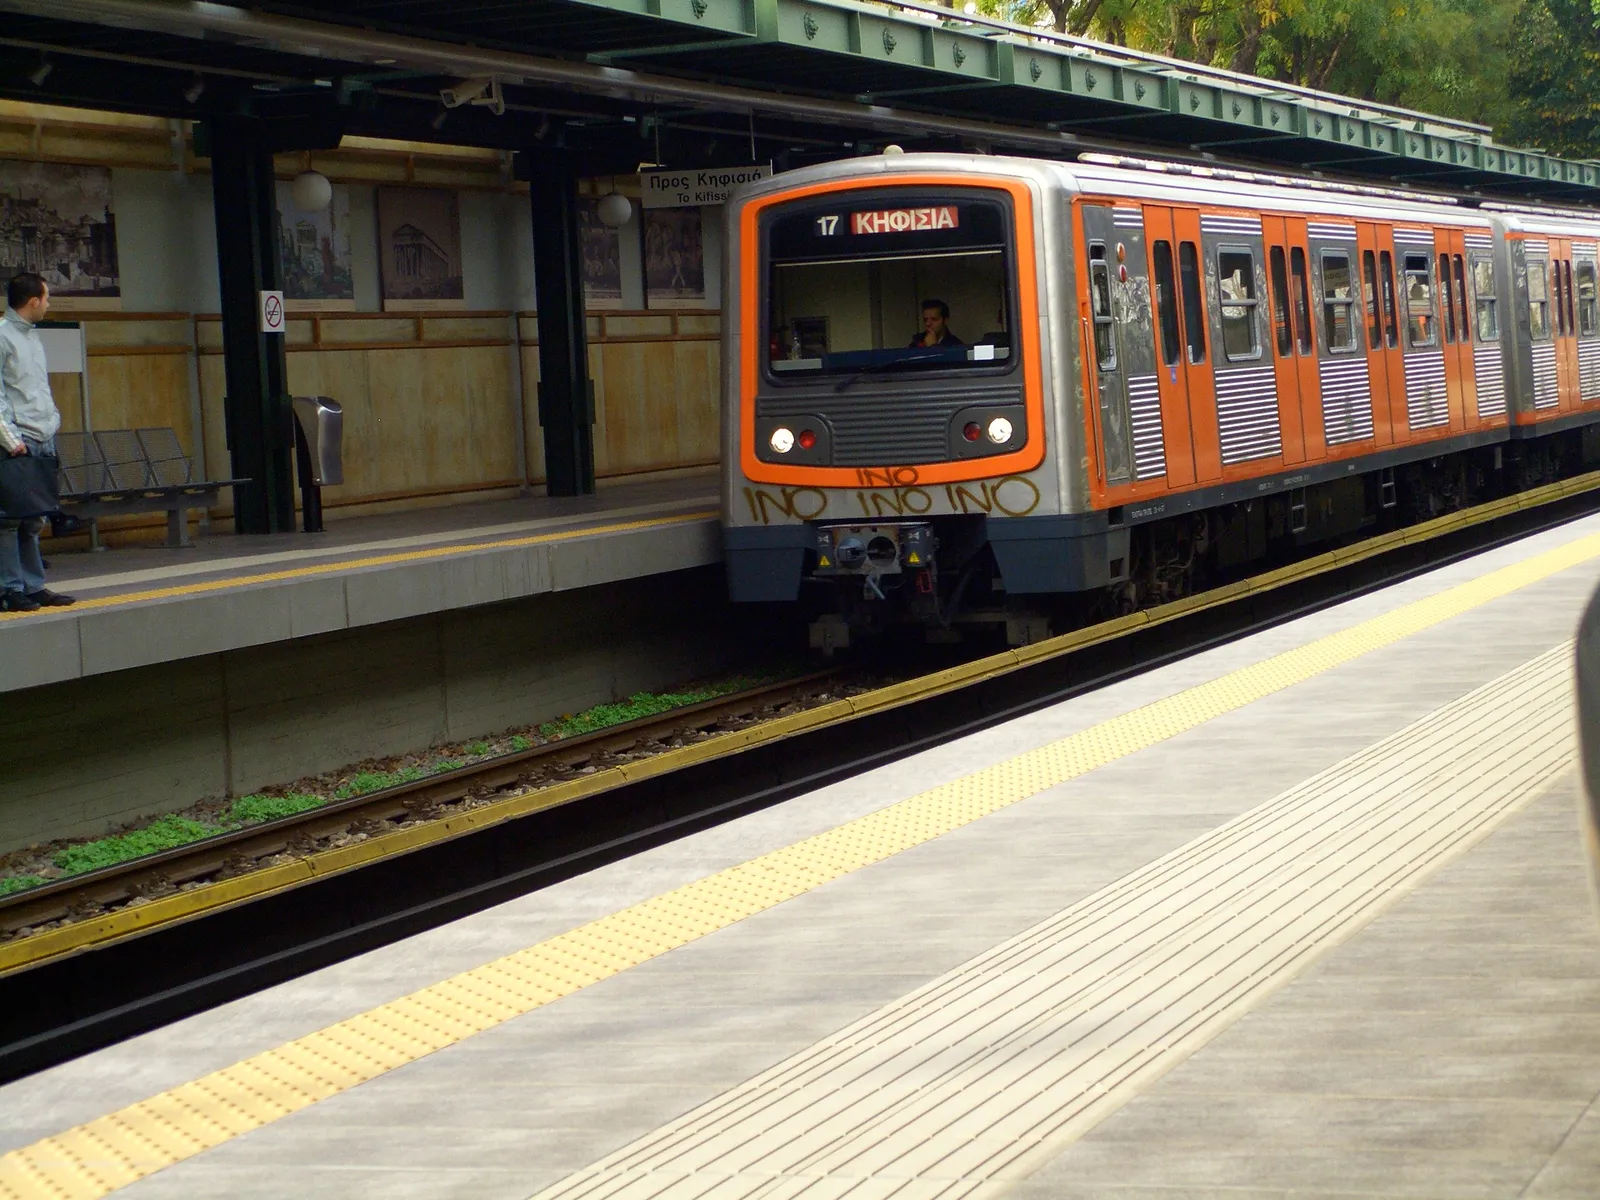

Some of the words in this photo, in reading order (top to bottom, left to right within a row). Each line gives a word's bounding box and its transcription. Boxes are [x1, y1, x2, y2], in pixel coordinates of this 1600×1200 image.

[650, 175, 690, 191] Προς
[697, 169, 762, 188] Κηφισιά
[677, 193, 690, 203] To
[695, 190, 731, 202] Kifissi
[816, 215, 839, 236] 17
[856, 207, 955, 235] ΚΗΦΙΣΙΑ
[855, 466, 920, 488] INO
[743, 486, 829, 525] INO
[856, 487, 933, 517] INO
[944, 475, 1041, 518] INO
